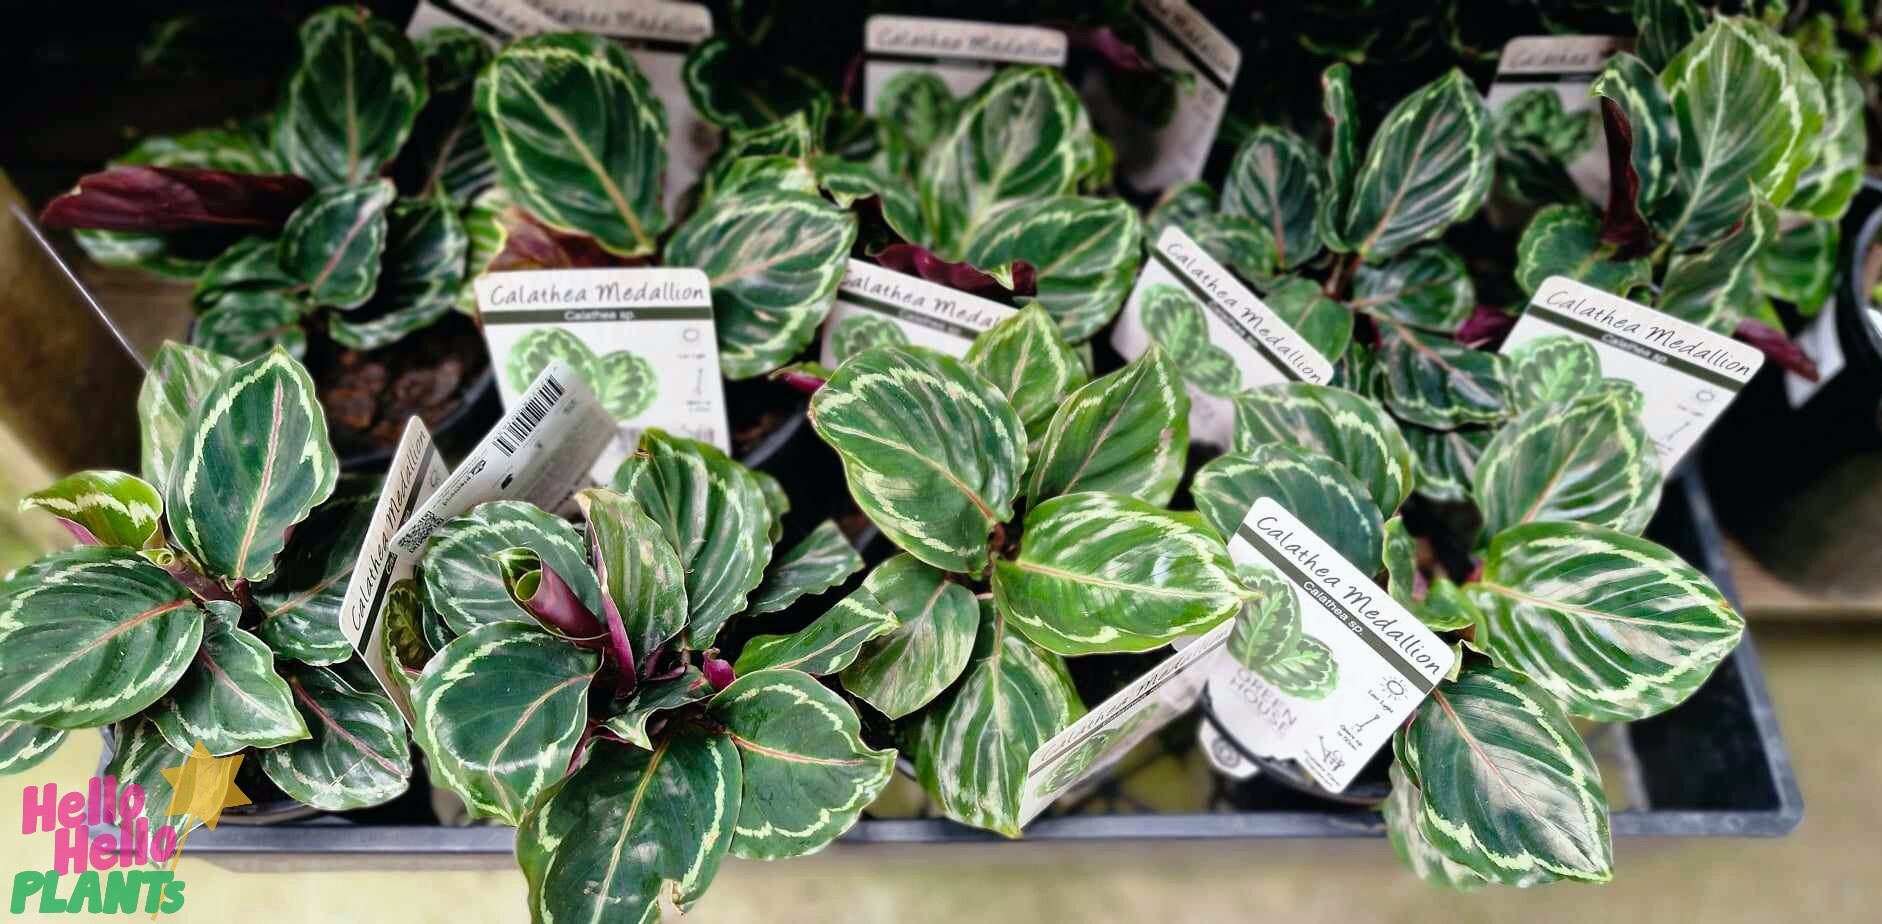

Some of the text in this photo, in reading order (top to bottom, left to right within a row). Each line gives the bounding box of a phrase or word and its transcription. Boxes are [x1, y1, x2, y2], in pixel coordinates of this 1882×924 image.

[489, 281, 704, 306] Calathea Medallion
[564, 309, 617, 322] Calathea
[1167, 242, 1237, 308] Calathea
[1241, 305, 1321, 383] Medallion
[1546, 289, 1750, 377] Calathea Medallion
[350, 430, 426, 632] Calathea Medallion
[1256, 515, 1441, 675] Calathea Medallion
[1303, 581, 1349, 621] Calathea
[1230, 676, 1289, 736] HOUSE
[1237, 667, 1297, 726] GREEN
